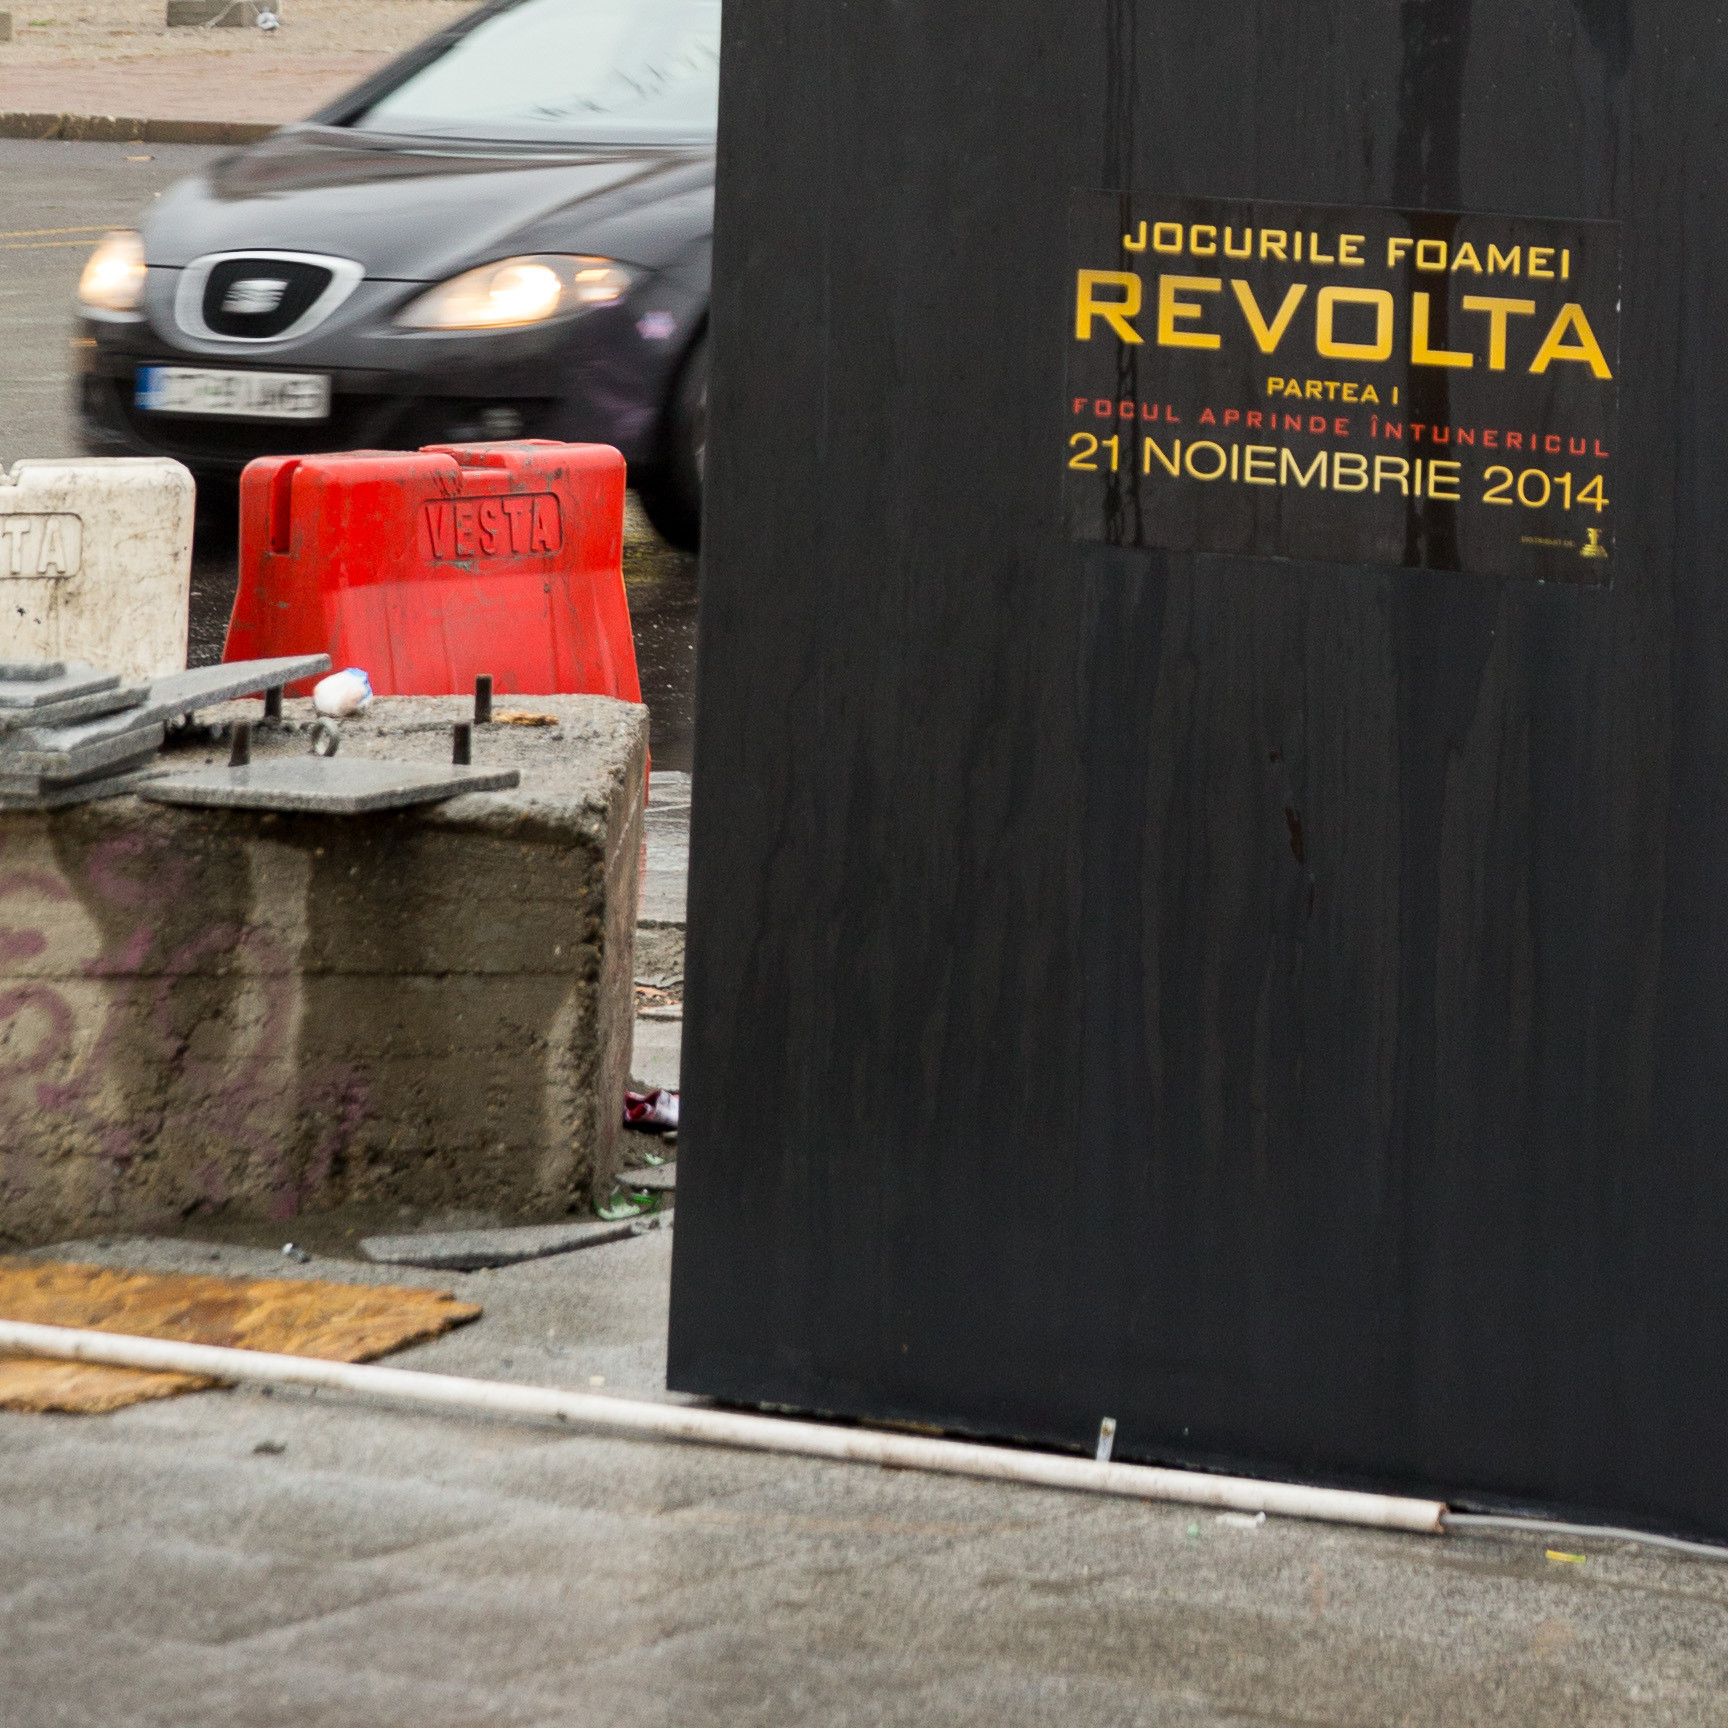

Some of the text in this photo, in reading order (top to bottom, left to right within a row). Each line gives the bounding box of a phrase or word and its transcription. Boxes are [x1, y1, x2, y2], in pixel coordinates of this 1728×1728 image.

[1123, 220, 1571, 279] JOCURILE FOAMEI
[1074, 269, 1613, 380] REVOLTA
[1266, 376, 1400, 406] PARTEA I
[1072, 396, 1611, 459] FOCUL APRINDE ÎNTUNERICUL
[1067, 431, 1611, 513] 21 NOIEMBRIE 2014
[424, 495, 556, 560] VESTA
